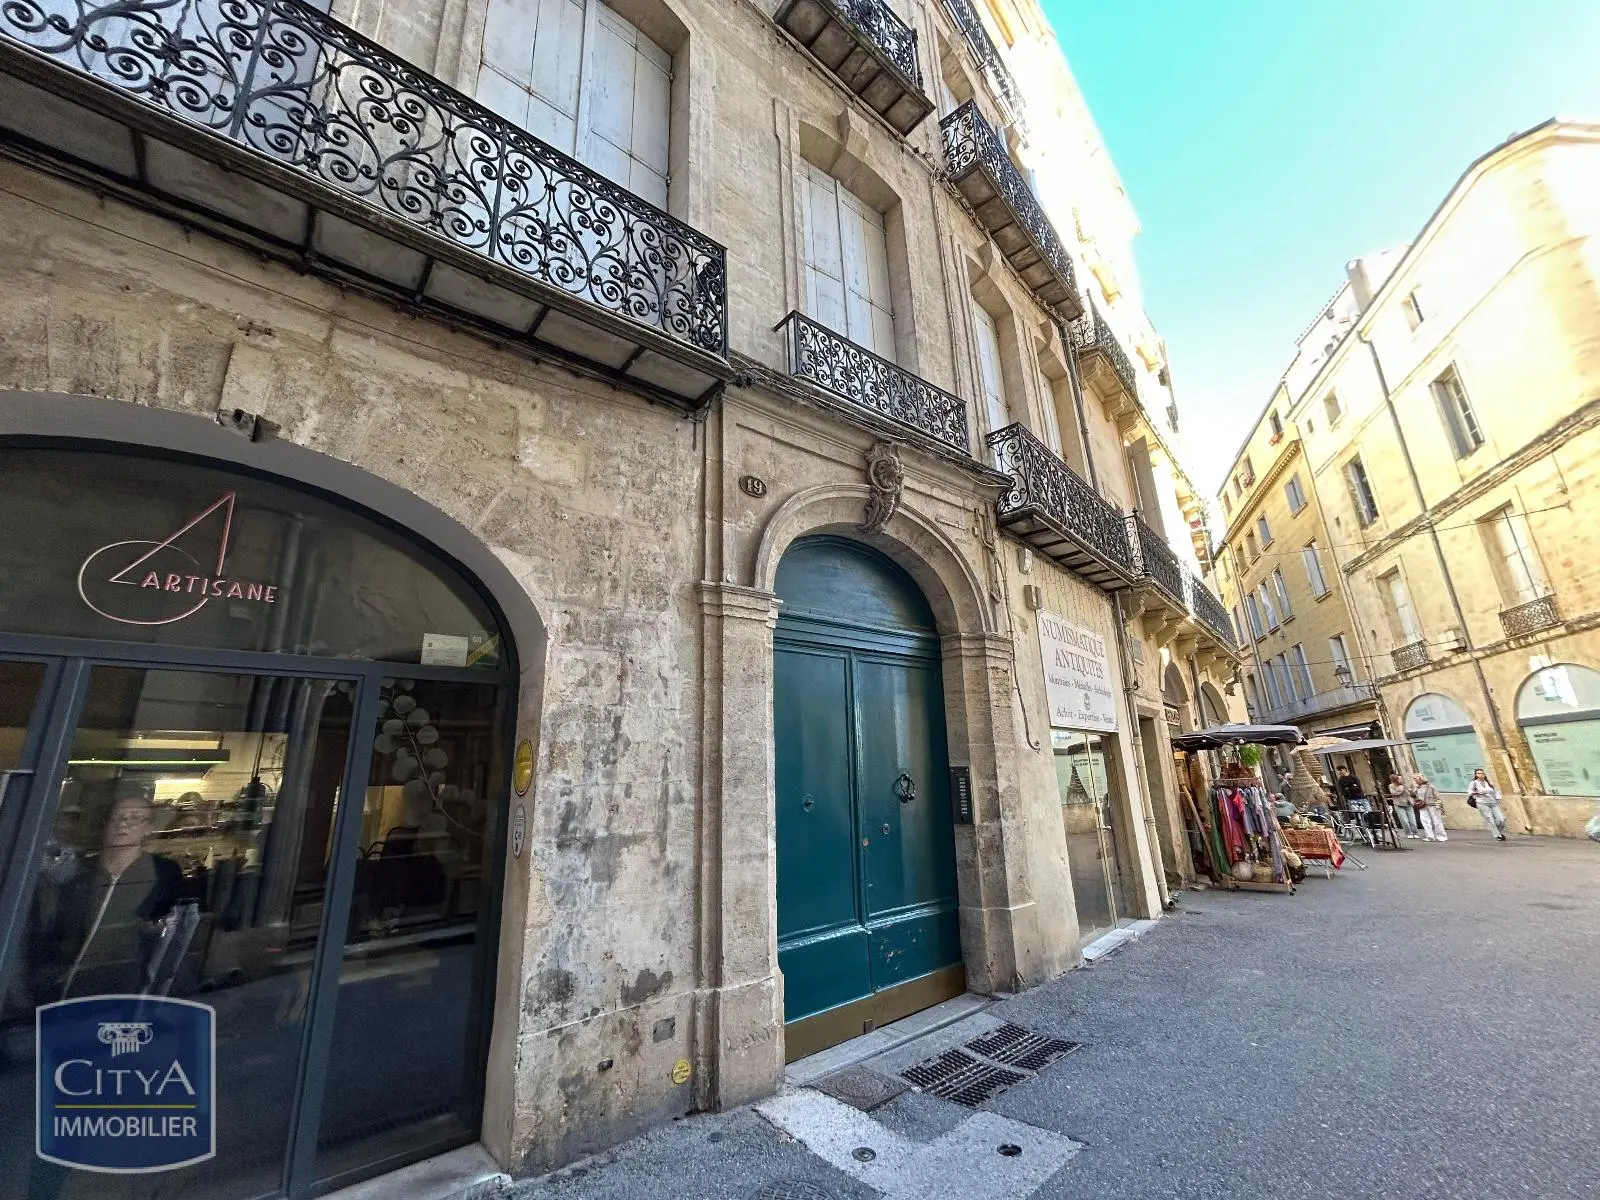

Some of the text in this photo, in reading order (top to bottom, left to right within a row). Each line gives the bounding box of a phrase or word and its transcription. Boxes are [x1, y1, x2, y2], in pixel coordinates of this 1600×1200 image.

[746, 477, 763, 494] 19
[141, 570, 278, 603] ARTISANE
[1041, 616, 1105, 659] NUMISMATIQUE
